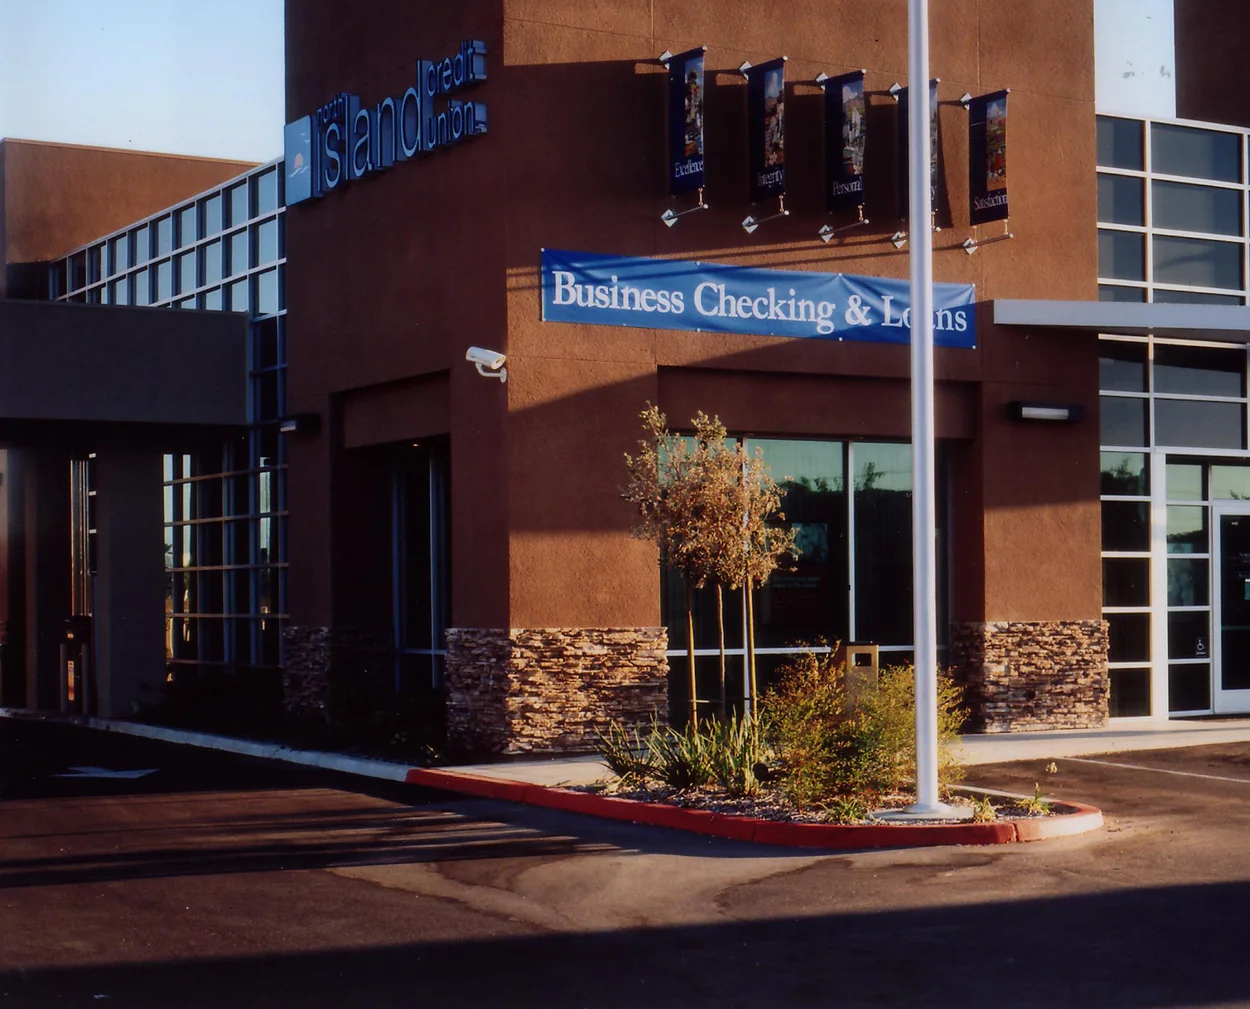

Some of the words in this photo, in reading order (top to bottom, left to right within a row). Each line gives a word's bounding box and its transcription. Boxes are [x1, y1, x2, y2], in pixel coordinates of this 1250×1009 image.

[427, 40, 486, 96] credit
[316, 94, 346, 126] north
[316, 59, 425, 193] island
[427, 100, 486, 149] union
[757, 170, 785, 188] Integrity
[832, 176, 863, 196] Personal
[974, 191, 1007, 210] Satisfaction
[552, 270, 685, 314] Business
[693, 282, 836, 334] Checking
[844, 295, 872, 326] &
